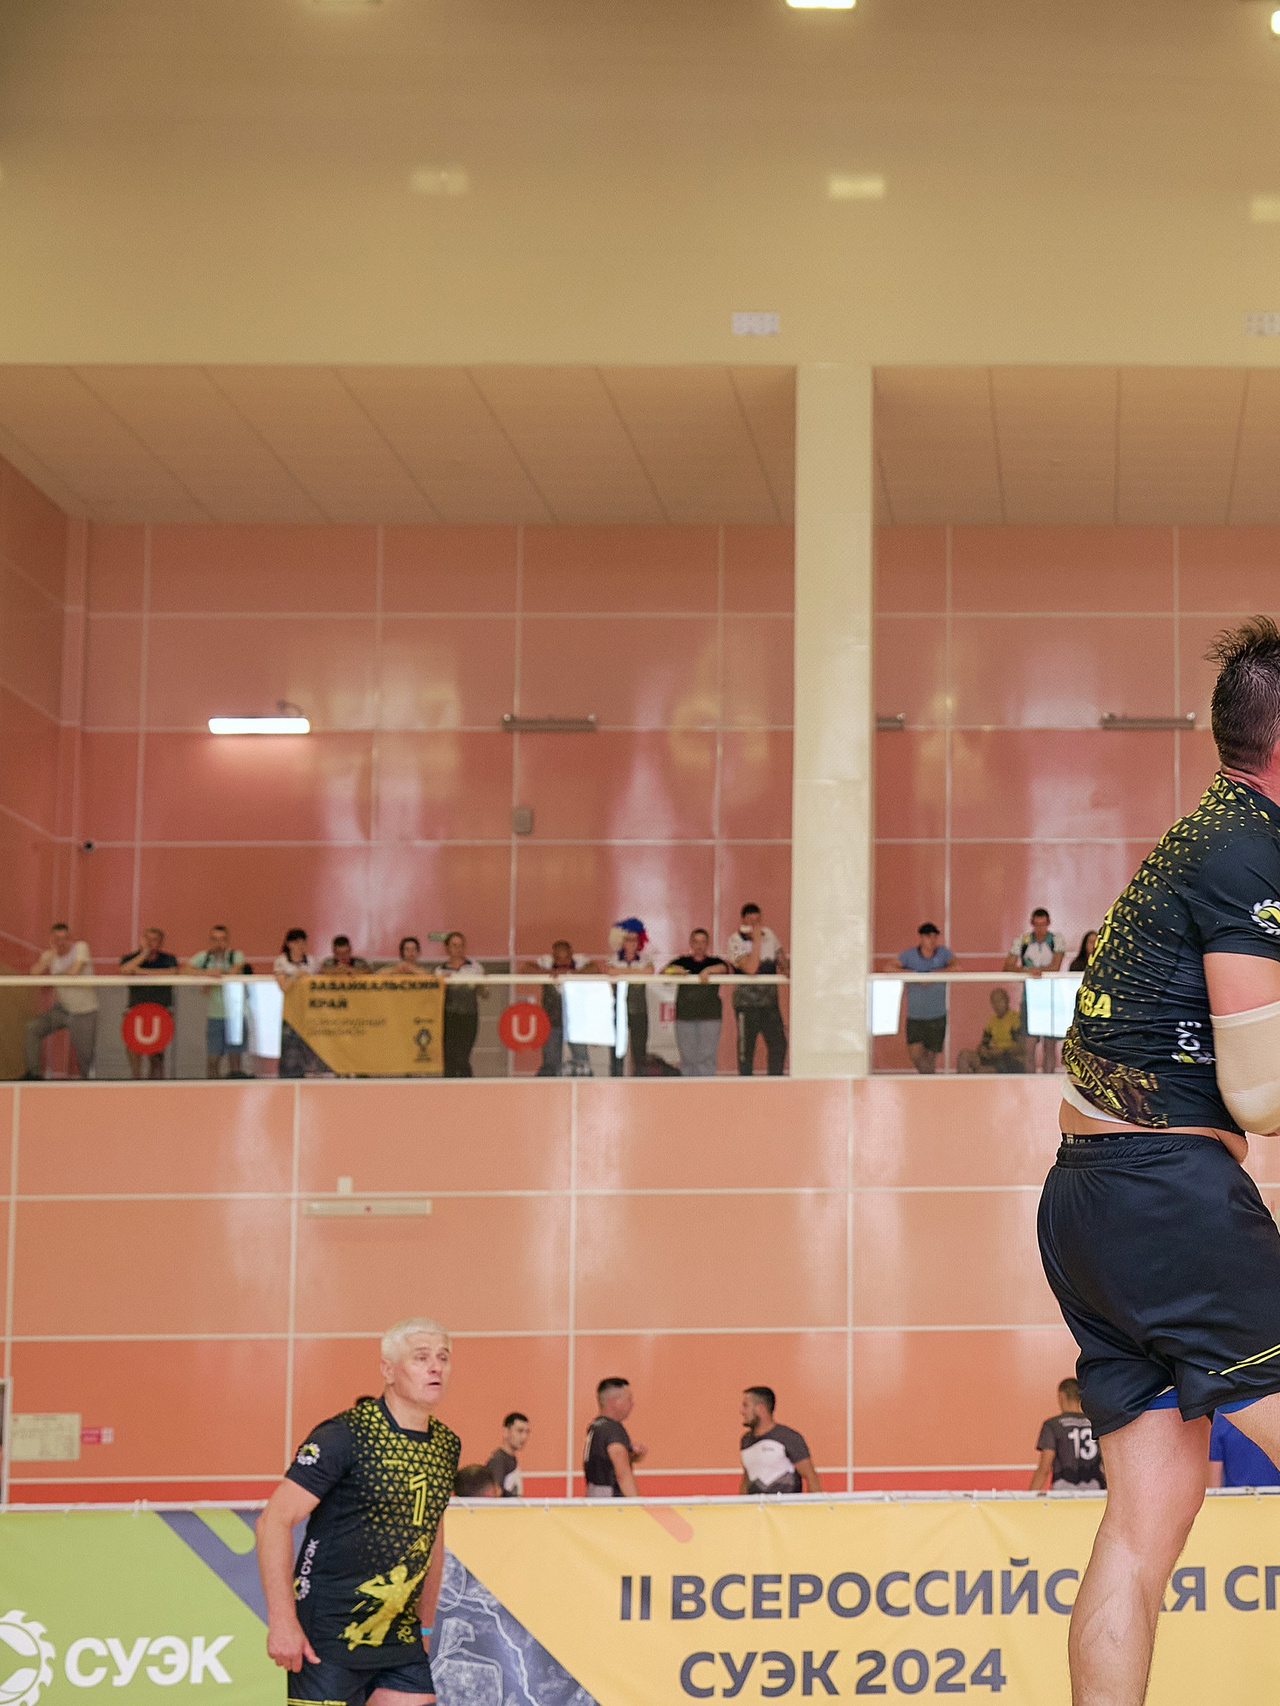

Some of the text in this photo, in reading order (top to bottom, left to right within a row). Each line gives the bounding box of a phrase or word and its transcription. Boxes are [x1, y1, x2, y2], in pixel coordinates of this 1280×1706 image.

[133, 1015, 162, 1045] U
[511, 1014, 537, 1043] U
[1067, 1427, 1098, 1460] 13
[409, 1472, 427, 1526] 1
[620, 1575, 652, 1621] II
[64, 1635, 235, 1687] СУЭК
[680, 1648, 1007, 1698] СУЭК 2024
